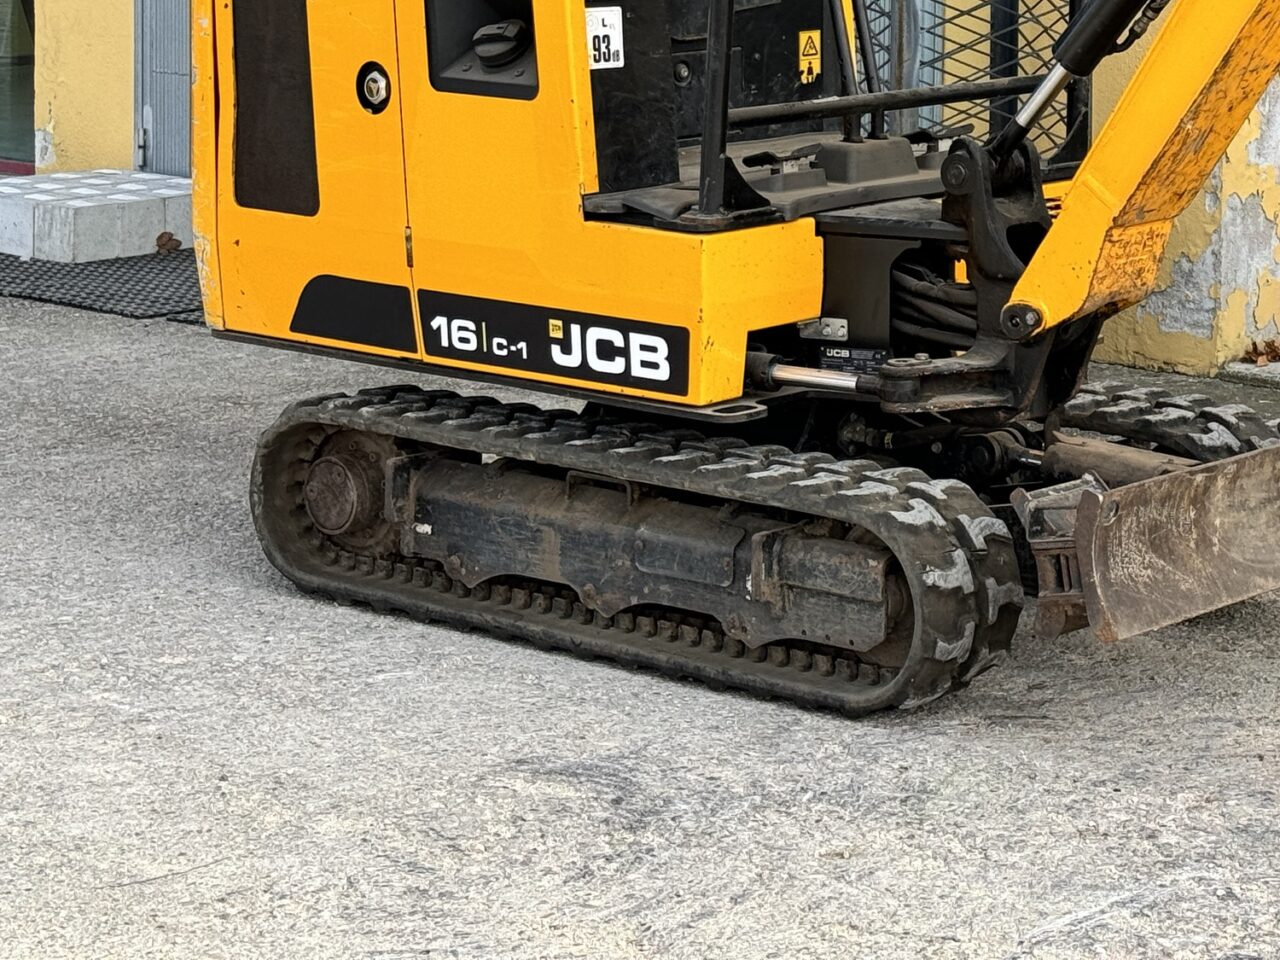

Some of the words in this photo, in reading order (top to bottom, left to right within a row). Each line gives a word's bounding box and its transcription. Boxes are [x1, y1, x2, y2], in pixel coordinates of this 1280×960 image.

[592, 34, 611, 63] 93
[430, 315, 478, 352] 16
[550, 323, 671, 382] JCB
[826, 348, 850, 358] JCB
